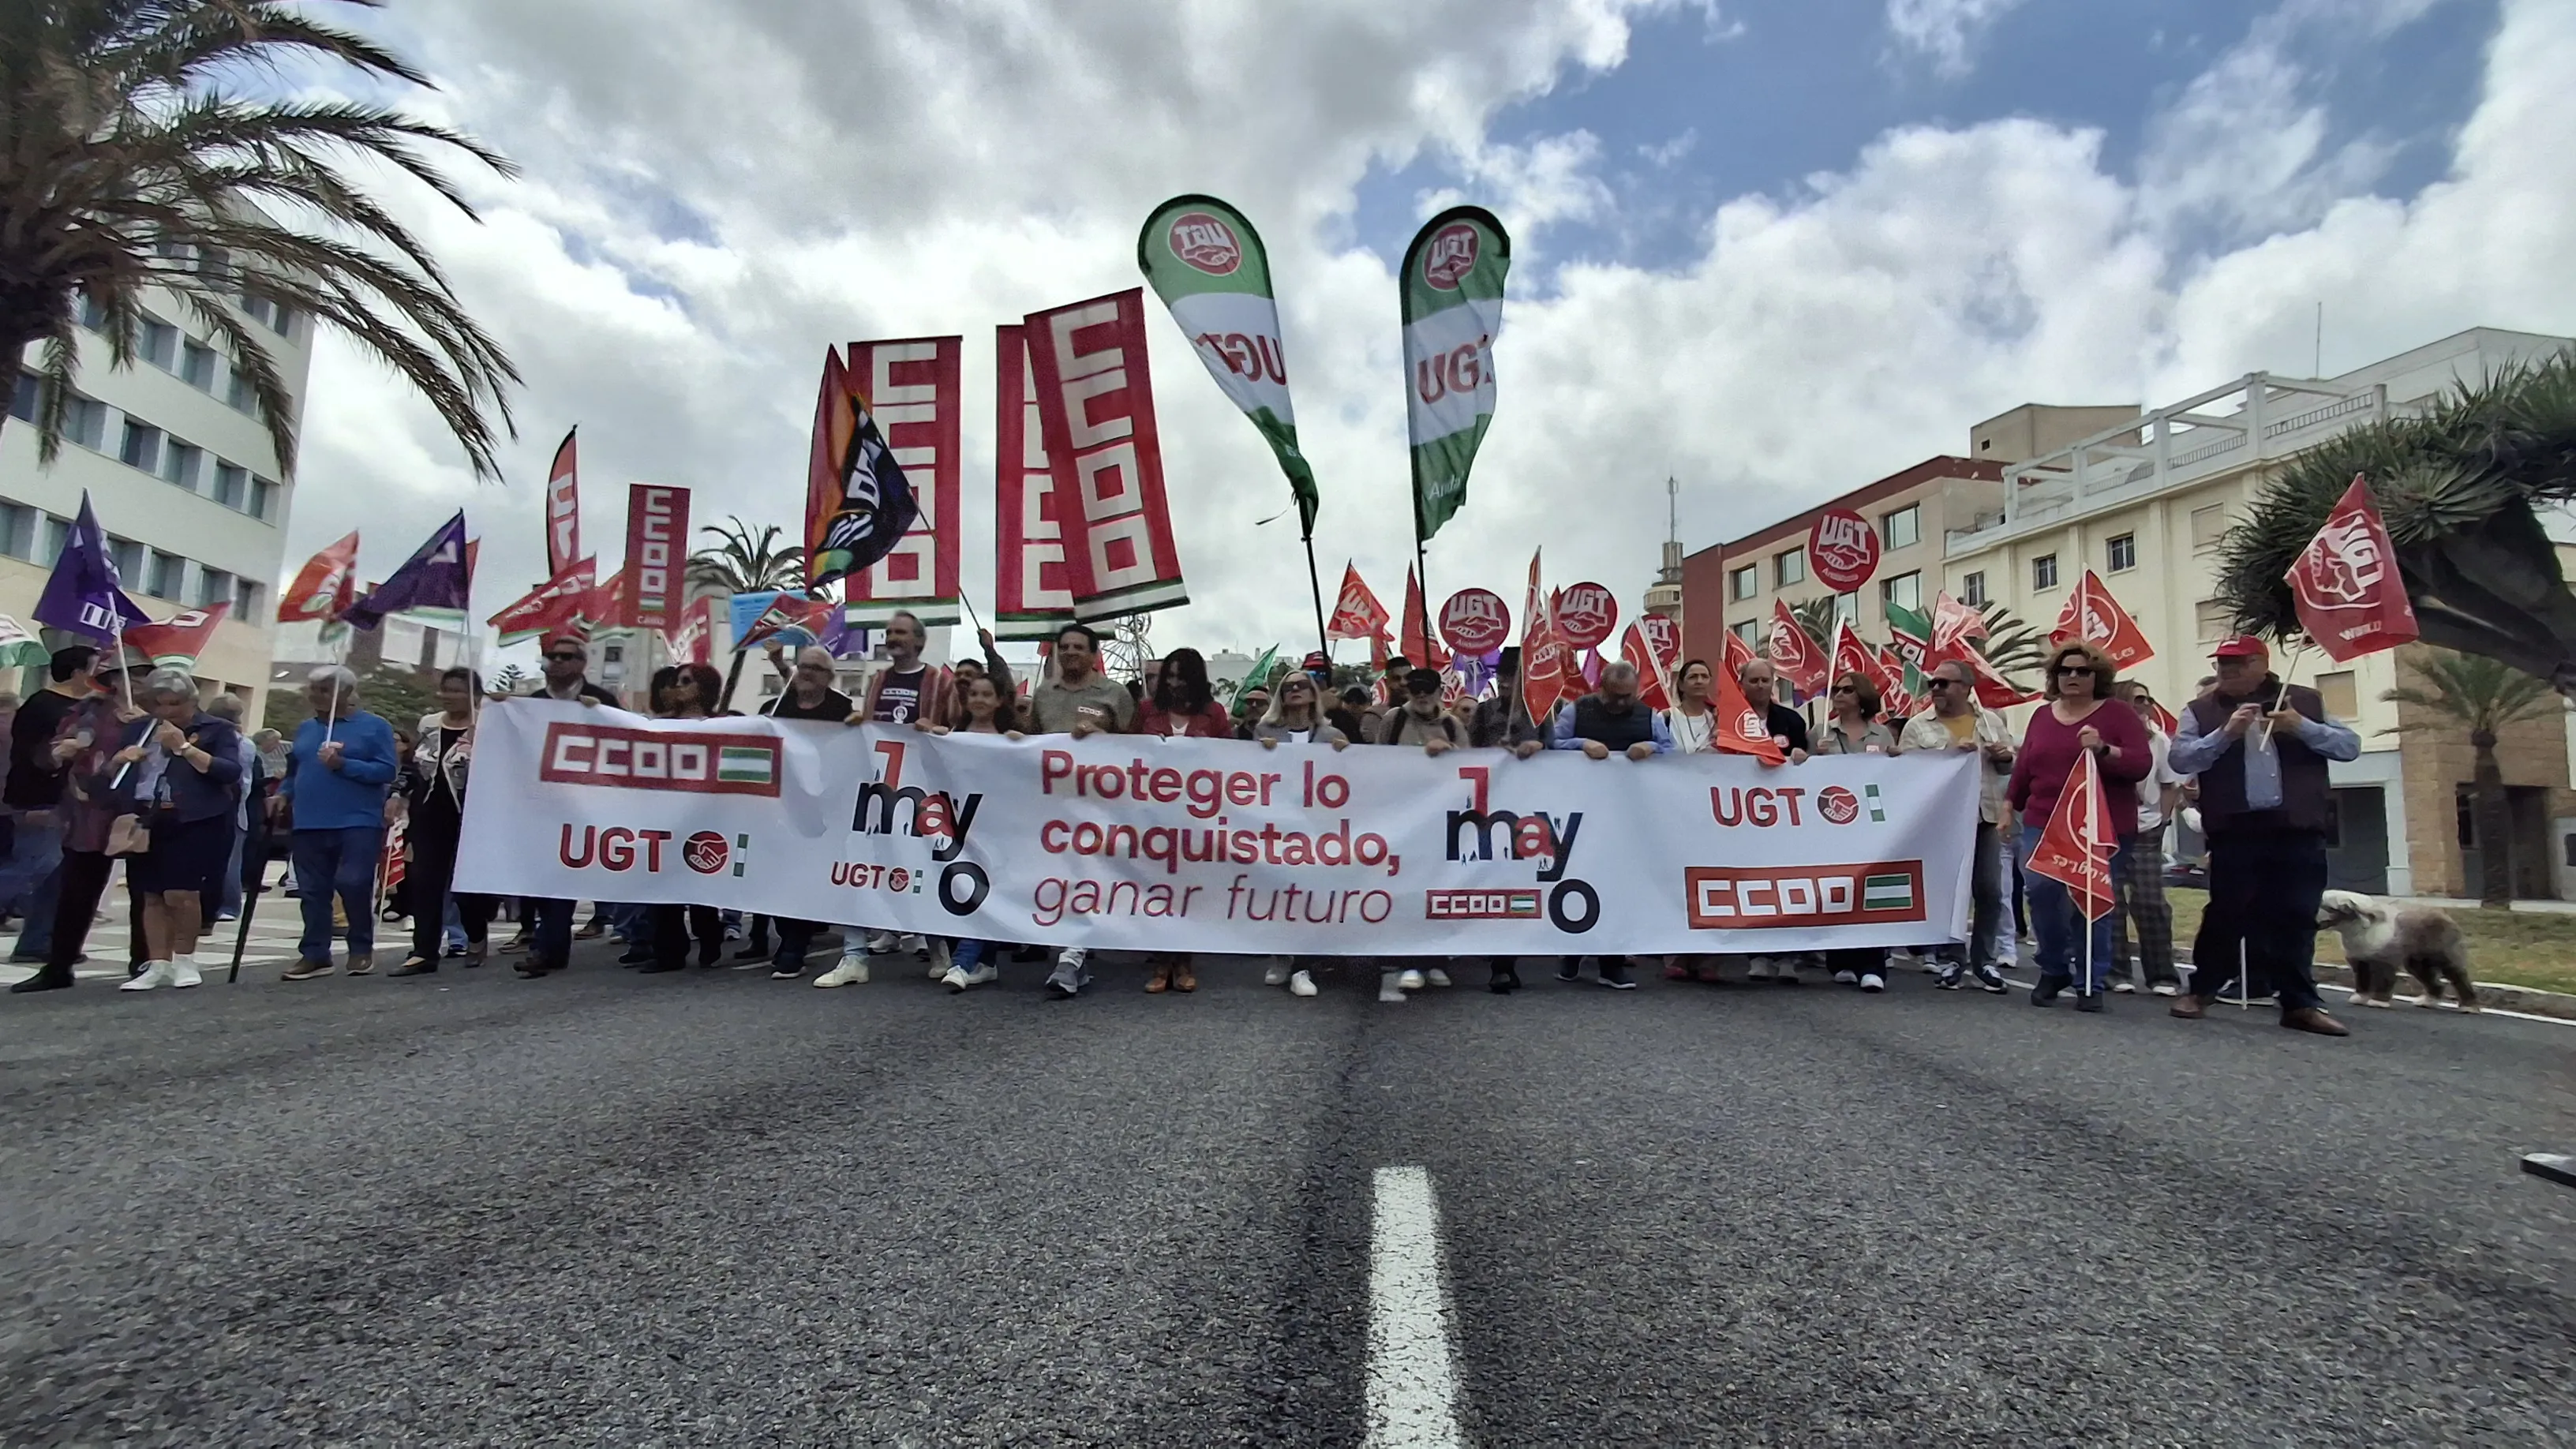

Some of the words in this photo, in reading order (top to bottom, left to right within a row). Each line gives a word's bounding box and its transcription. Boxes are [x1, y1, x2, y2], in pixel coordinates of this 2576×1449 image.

[1432, 231, 1473, 268] UGT
[1050, 301, 1157, 592] CCOO
[641, 489, 672, 593] CCOO
[1819, 515, 1869, 552] UGT
[1449, 594, 1499, 622] UGT
[1559, 589, 1608, 616] UGT
[1645, 619, 1671, 641] GT
[552, 734, 707, 780] CCOO
[874, 739, 905, 790] 1
[1042, 750, 1281, 818] Proteger
[1303, 760, 1350, 809] lo
[1458, 767, 1488, 816] 1
[1710, 786, 1806, 826] UGT
[559, 823, 672, 873] UGT
[1040, 817, 1400, 877] conquistado,
[831, 861, 886, 889] UGT
[1697, 876, 1855, 916] CCOO
[1032, 876, 1203, 927] ganar
[1227, 874, 1393, 923] futuro
[1431, 895, 1506, 914] CCOO
